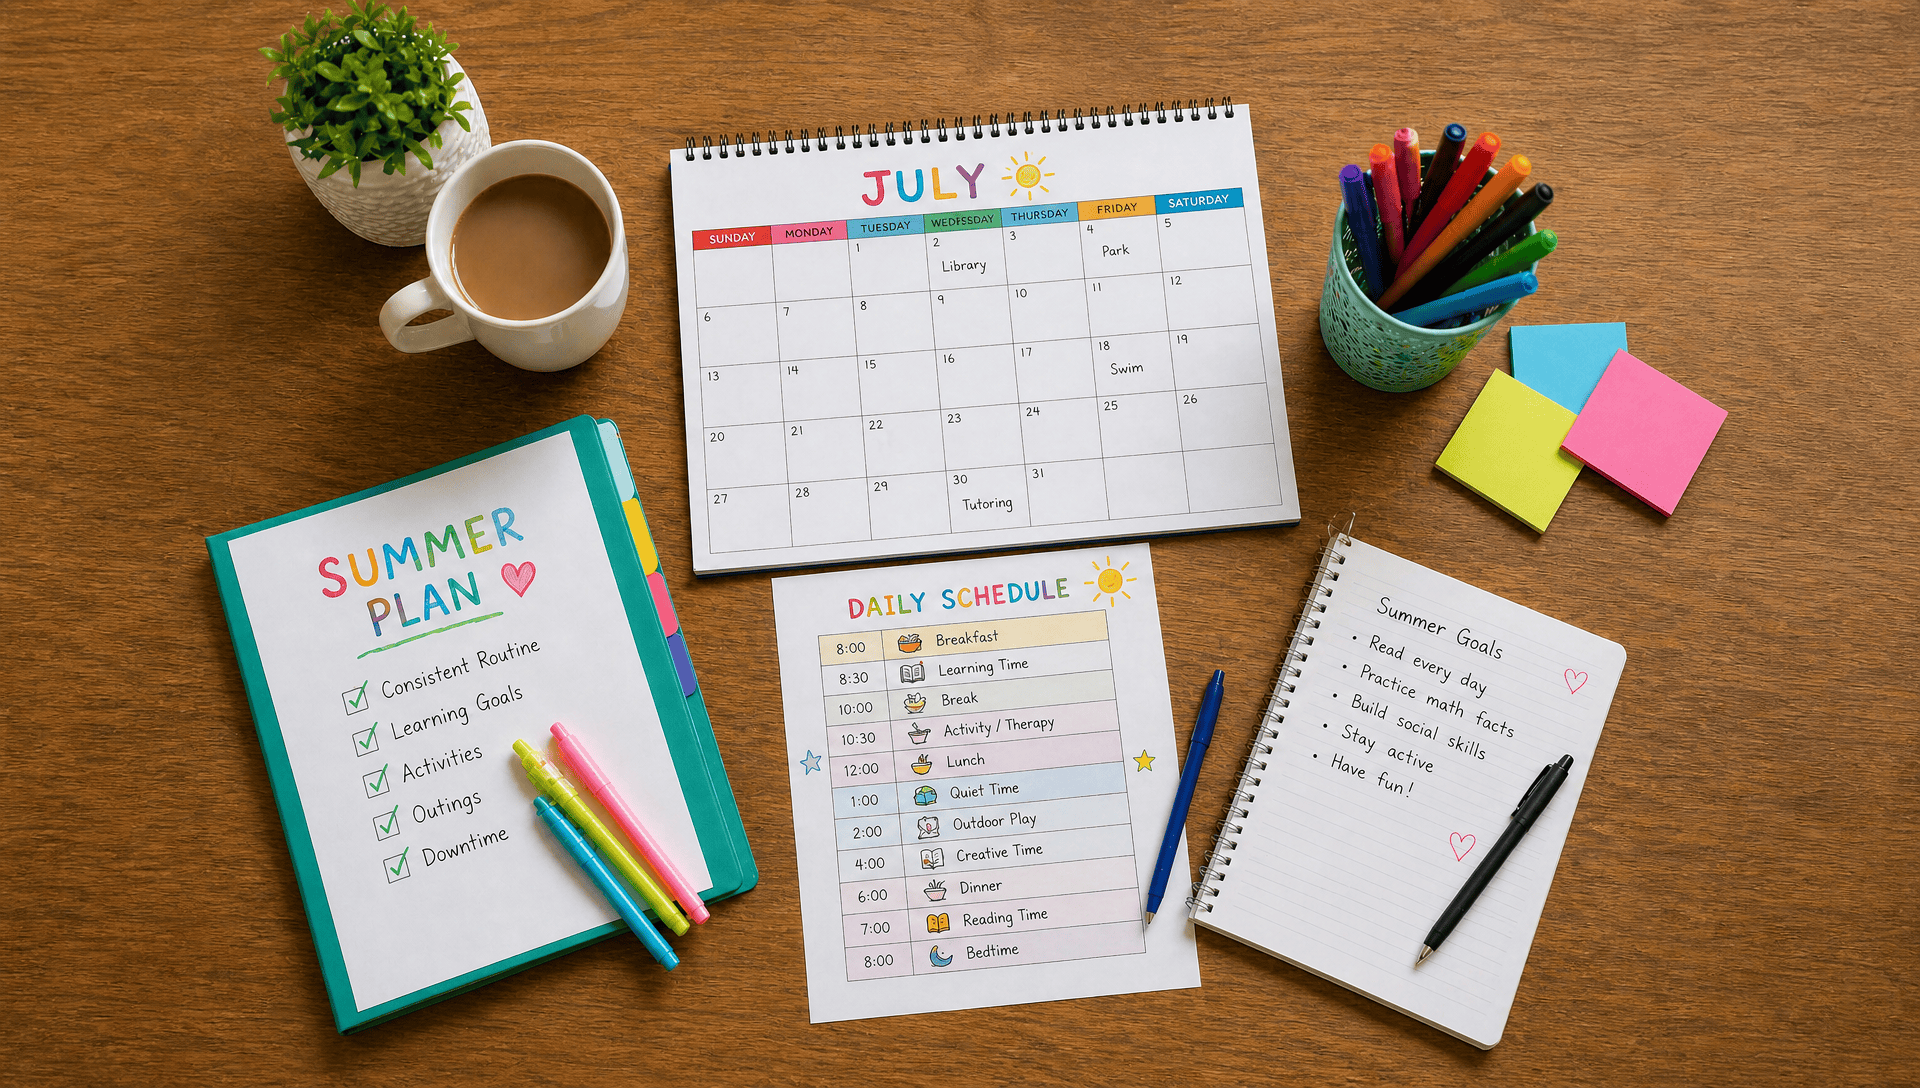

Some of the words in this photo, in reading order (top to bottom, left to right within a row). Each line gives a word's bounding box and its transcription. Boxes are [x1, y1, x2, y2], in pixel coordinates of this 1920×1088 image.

[862, 163, 984, 206] JULY
[1167, 194, 1230, 208] SATURDAY
[1010, 208, 1069, 221] THURSDAY
[1096, 202, 1138, 214] FRIDAY
[861, 221, 912, 234] TUESDAY
[1086, 224, 1094, 234] 4
[1164, 217, 1172, 228] 5
[709, 231, 756, 245] SUNDAY
[784, 226, 833, 238] MONDAY
[1009, 230, 1017, 241] 3
[932, 237, 941, 248] 2
[1103, 244, 1129, 257] Park
[942, 261, 986, 274] Library
[1092, 282, 1102, 292] 11
[1170, 275, 1183, 286] 12
[937, 294, 945, 305] 9
[1015, 288, 1028, 299] 10
[782, 306, 790, 317] 7
[860, 300, 867, 311] 8
[703, 311, 712, 323] 6
[1098, 340, 1111, 351] 18
[1176, 333, 1188, 345] 19
[943, 353, 955, 364] 16
[1021, 347, 1032, 358] 17
[787, 365, 799, 376] 14
[865, 359, 877, 370] 15
[1111, 363, 1143, 375] Swim
[708, 370, 720, 382] 13
[1183, 393, 1198, 405] 26
[1025, 406, 1040, 417] 24
[1103, 400, 1119, 412] 25
[947, 412, 962, 424] 23
[790, 425, 803, 437] 21
[868, 419, 884, 431] 22
[710, 431, 725, 443] 20
[953, 474, 968, 485] 30
[1031, 467, 1044, 479] 31
[795, 486, 810, 499] 28
[873, 480, 888, 492] 29
[713, 493, 728, 505] 27
[962, 499, 1012, 512] Tutoring
[318, 507, 525, 599] SUMMER
[366, 571, 482, 637] PLAN
[848, 592, 925, 619] DAILY
[942, 578, 1069, 609] SCHEDULE
[1375, 597, 1446, 638] Summer
[1457, 628, 1502, 659] Goals
[937, 630, 998, 646] Breakfast
[837, 642, 865, 655] 8:00
[382, 658, 469, 698] Consistent
[477, 640, 540, 668] Routine
[939, 664, 993, 676] Learning
[998, 659, 1028, 670] Time
[1370, 635, 1405, 660] Read
[1413, 657, 1451, 683] every
[1461, 673, 1486, 698] day
[840, 672, 868, 685] 8:30
[942, 692, 978, 706] Break
[1360, 663, 1417, 699] Practice
[1427, 696, 1463, 717] math
[1477, 711, 1514, 737] facts
[391, 707, 468, 739] Learning
[477, 685, 522, 710] Goals
[840, 702, 872, 715] 10:00
[944, 722, 991, 737] Activity
[1005, 719, 1054, 731] Therapy
[1352, 694, 1388, 719] Build
[1397, 718, 1438, 740] social
[1448, 736, 1485, 759] skills
[842, 732, 875, 745] 10:30
[1342, 724, 1375, 753] Stay
[1386, 747, 1433, 774] active
[404, 747, 482, 782] Activities
[947, 753, 984, 767] Lunch
[845, 763, 878, 776] 12:00
[1332, 753, 1367, 779] Have
[1378, 772, 1413, 799] fun!
[951, 785, 984, 798] Quiet
[989, 783, 1019, 794] Time
[852, 795, 878, 807] 1:00
[413, 793, 481, 823] Outings
[954, 816, 1004, 830] Outdoor
[1010, 812, 1036, 828] Play
[853, 826, 882, 839] 2:00
[422, 830, 508, 866] Downtime
[957, 847, 1008, 861] Creative
[1013, 844, 1043, 855] Time
[856, 857, 884, 870] 4:00
[960, 882, 1002, 894] Dinner
[859, 889, 887, 903] 6:00
[964, 912, 1013, 927] Reading
[1018, 909, 1047, 920] Time
[861, 922, 890, 935] 7:00
[967, 945, 1019, 959] Bedtime
[865, 954, 893, 968] 8:00
